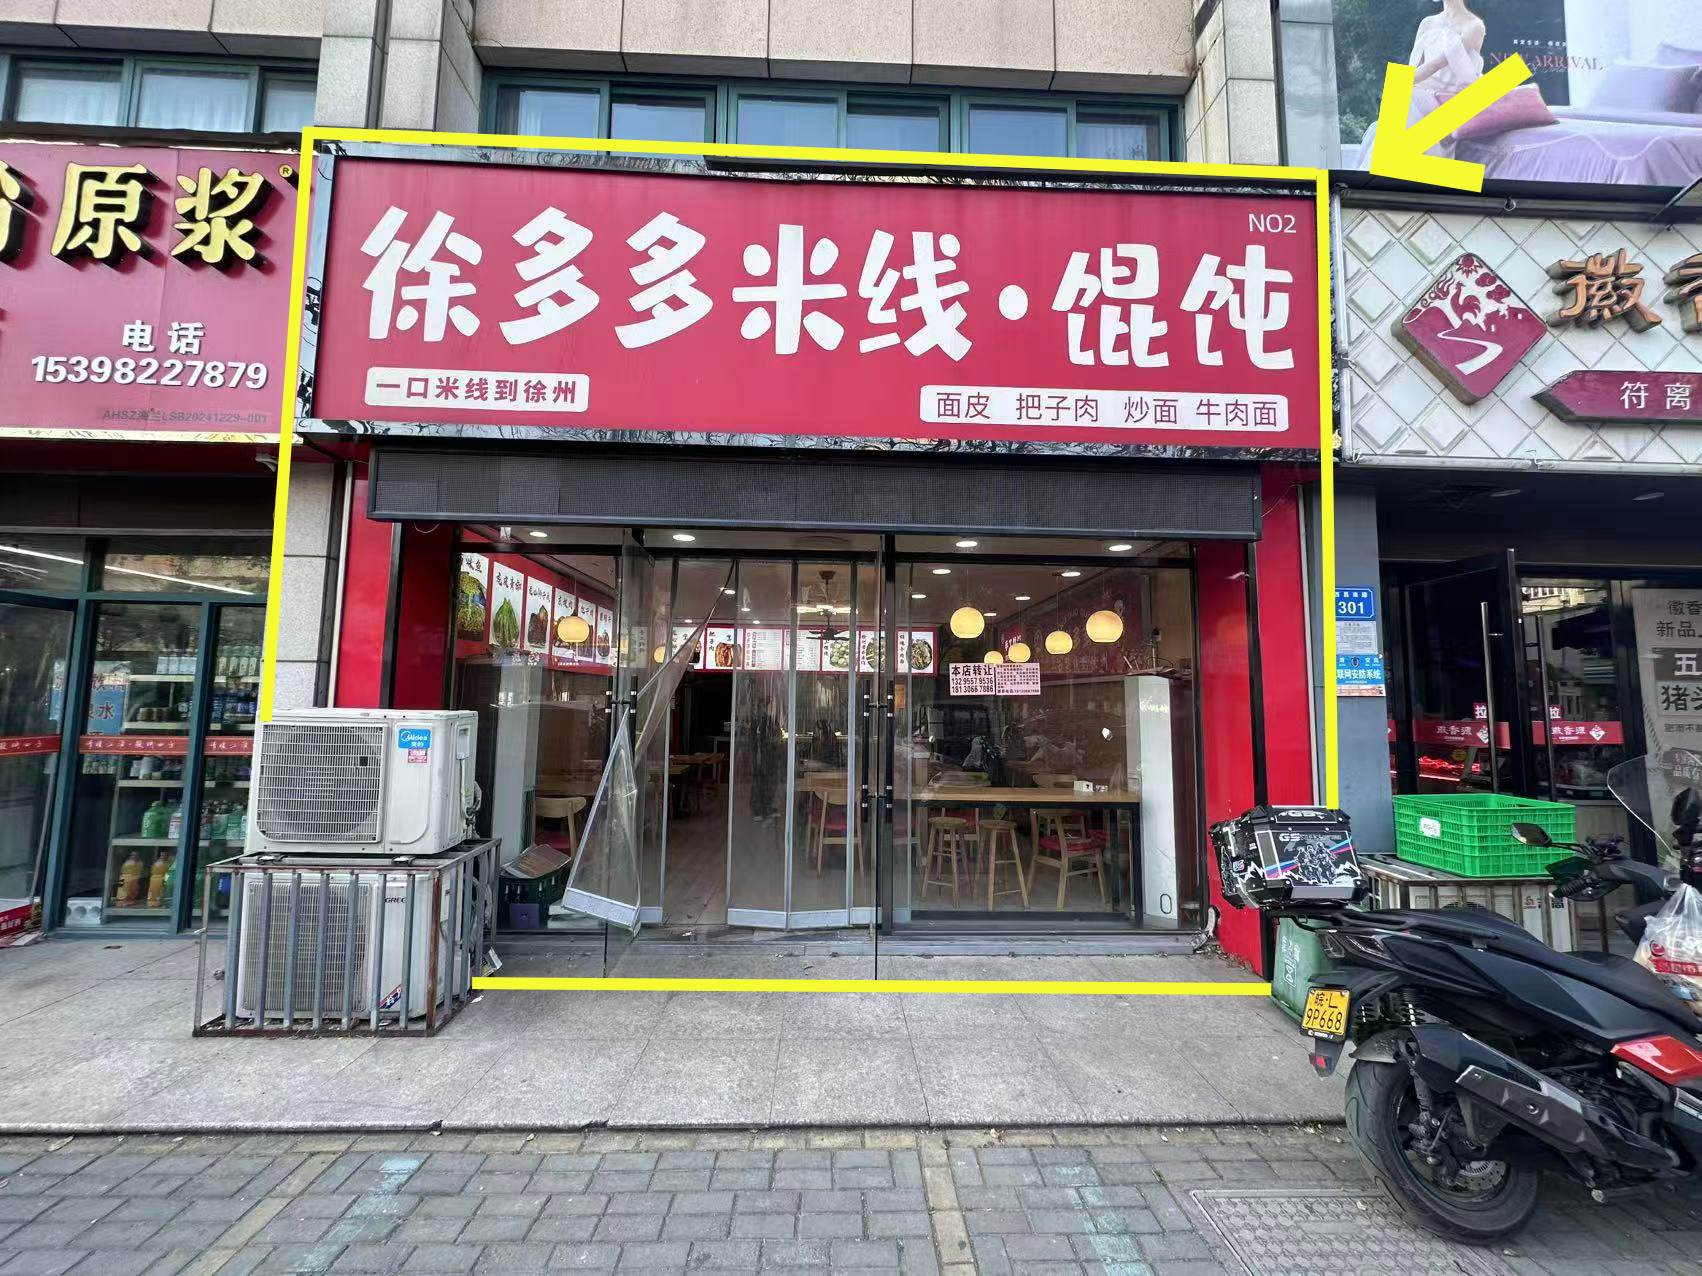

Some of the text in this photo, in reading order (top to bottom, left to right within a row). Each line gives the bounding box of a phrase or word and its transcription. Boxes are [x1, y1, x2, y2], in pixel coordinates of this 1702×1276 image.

[1534, 54, 1605, 70] ARRIVAL
[1247, 213, 1298, 234] NO2
[359, 205, 1296, 371] 徐多多米线·馄饨
[121, 320, 205, 355] 电话
[31, 355, 268, 390] 15398227879
[375, 375, 578, 405] 一口米线到徐州
[1619, 380, 1693, 410] 符离
[935, 391, 1279, 428] 面皮 把子肉 炒面 牛肉面
[1338, 601, 1365, 614] 301
[1656, 620, 1702, 638] 新品
[951, 664, 993, 677] 本店转让
[951, 678, 962, 686] 132
[979, 677, 994, 685] 9536
[1474, 704, 1487, 719] 拉
[1279, 833, 1301, 842] GS
[1305, 1008, 1343, 1031] 9P668
